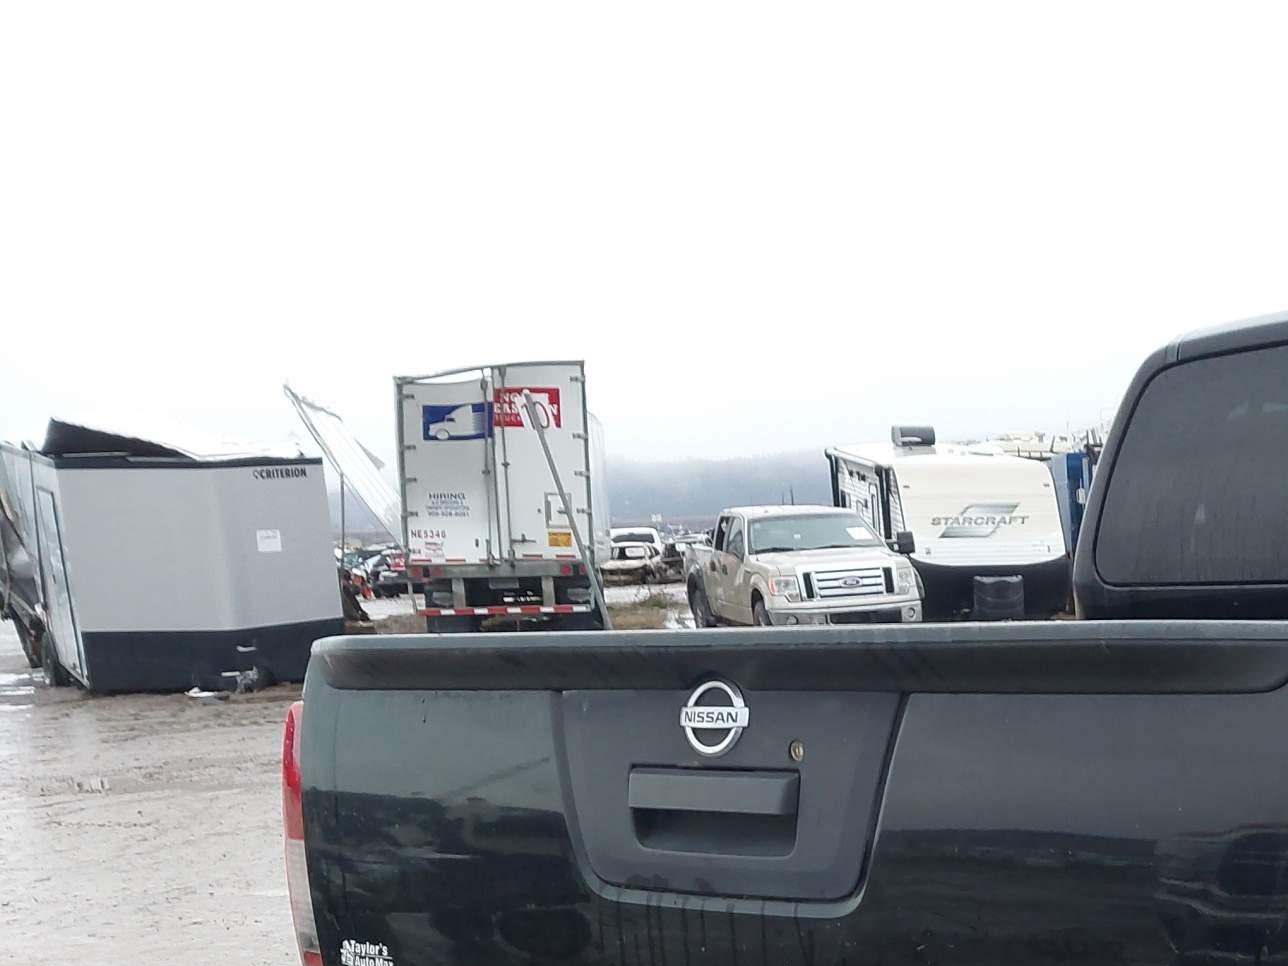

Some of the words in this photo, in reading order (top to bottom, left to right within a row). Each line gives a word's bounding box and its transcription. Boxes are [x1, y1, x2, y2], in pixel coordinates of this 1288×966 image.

[260, 467, 307, 480] CRITERION
[930, 515, 1030, 527] STARCRAFT
[684, 710, 739, 724] NISSAN
[350, 939, 388, 956] Taylor's
